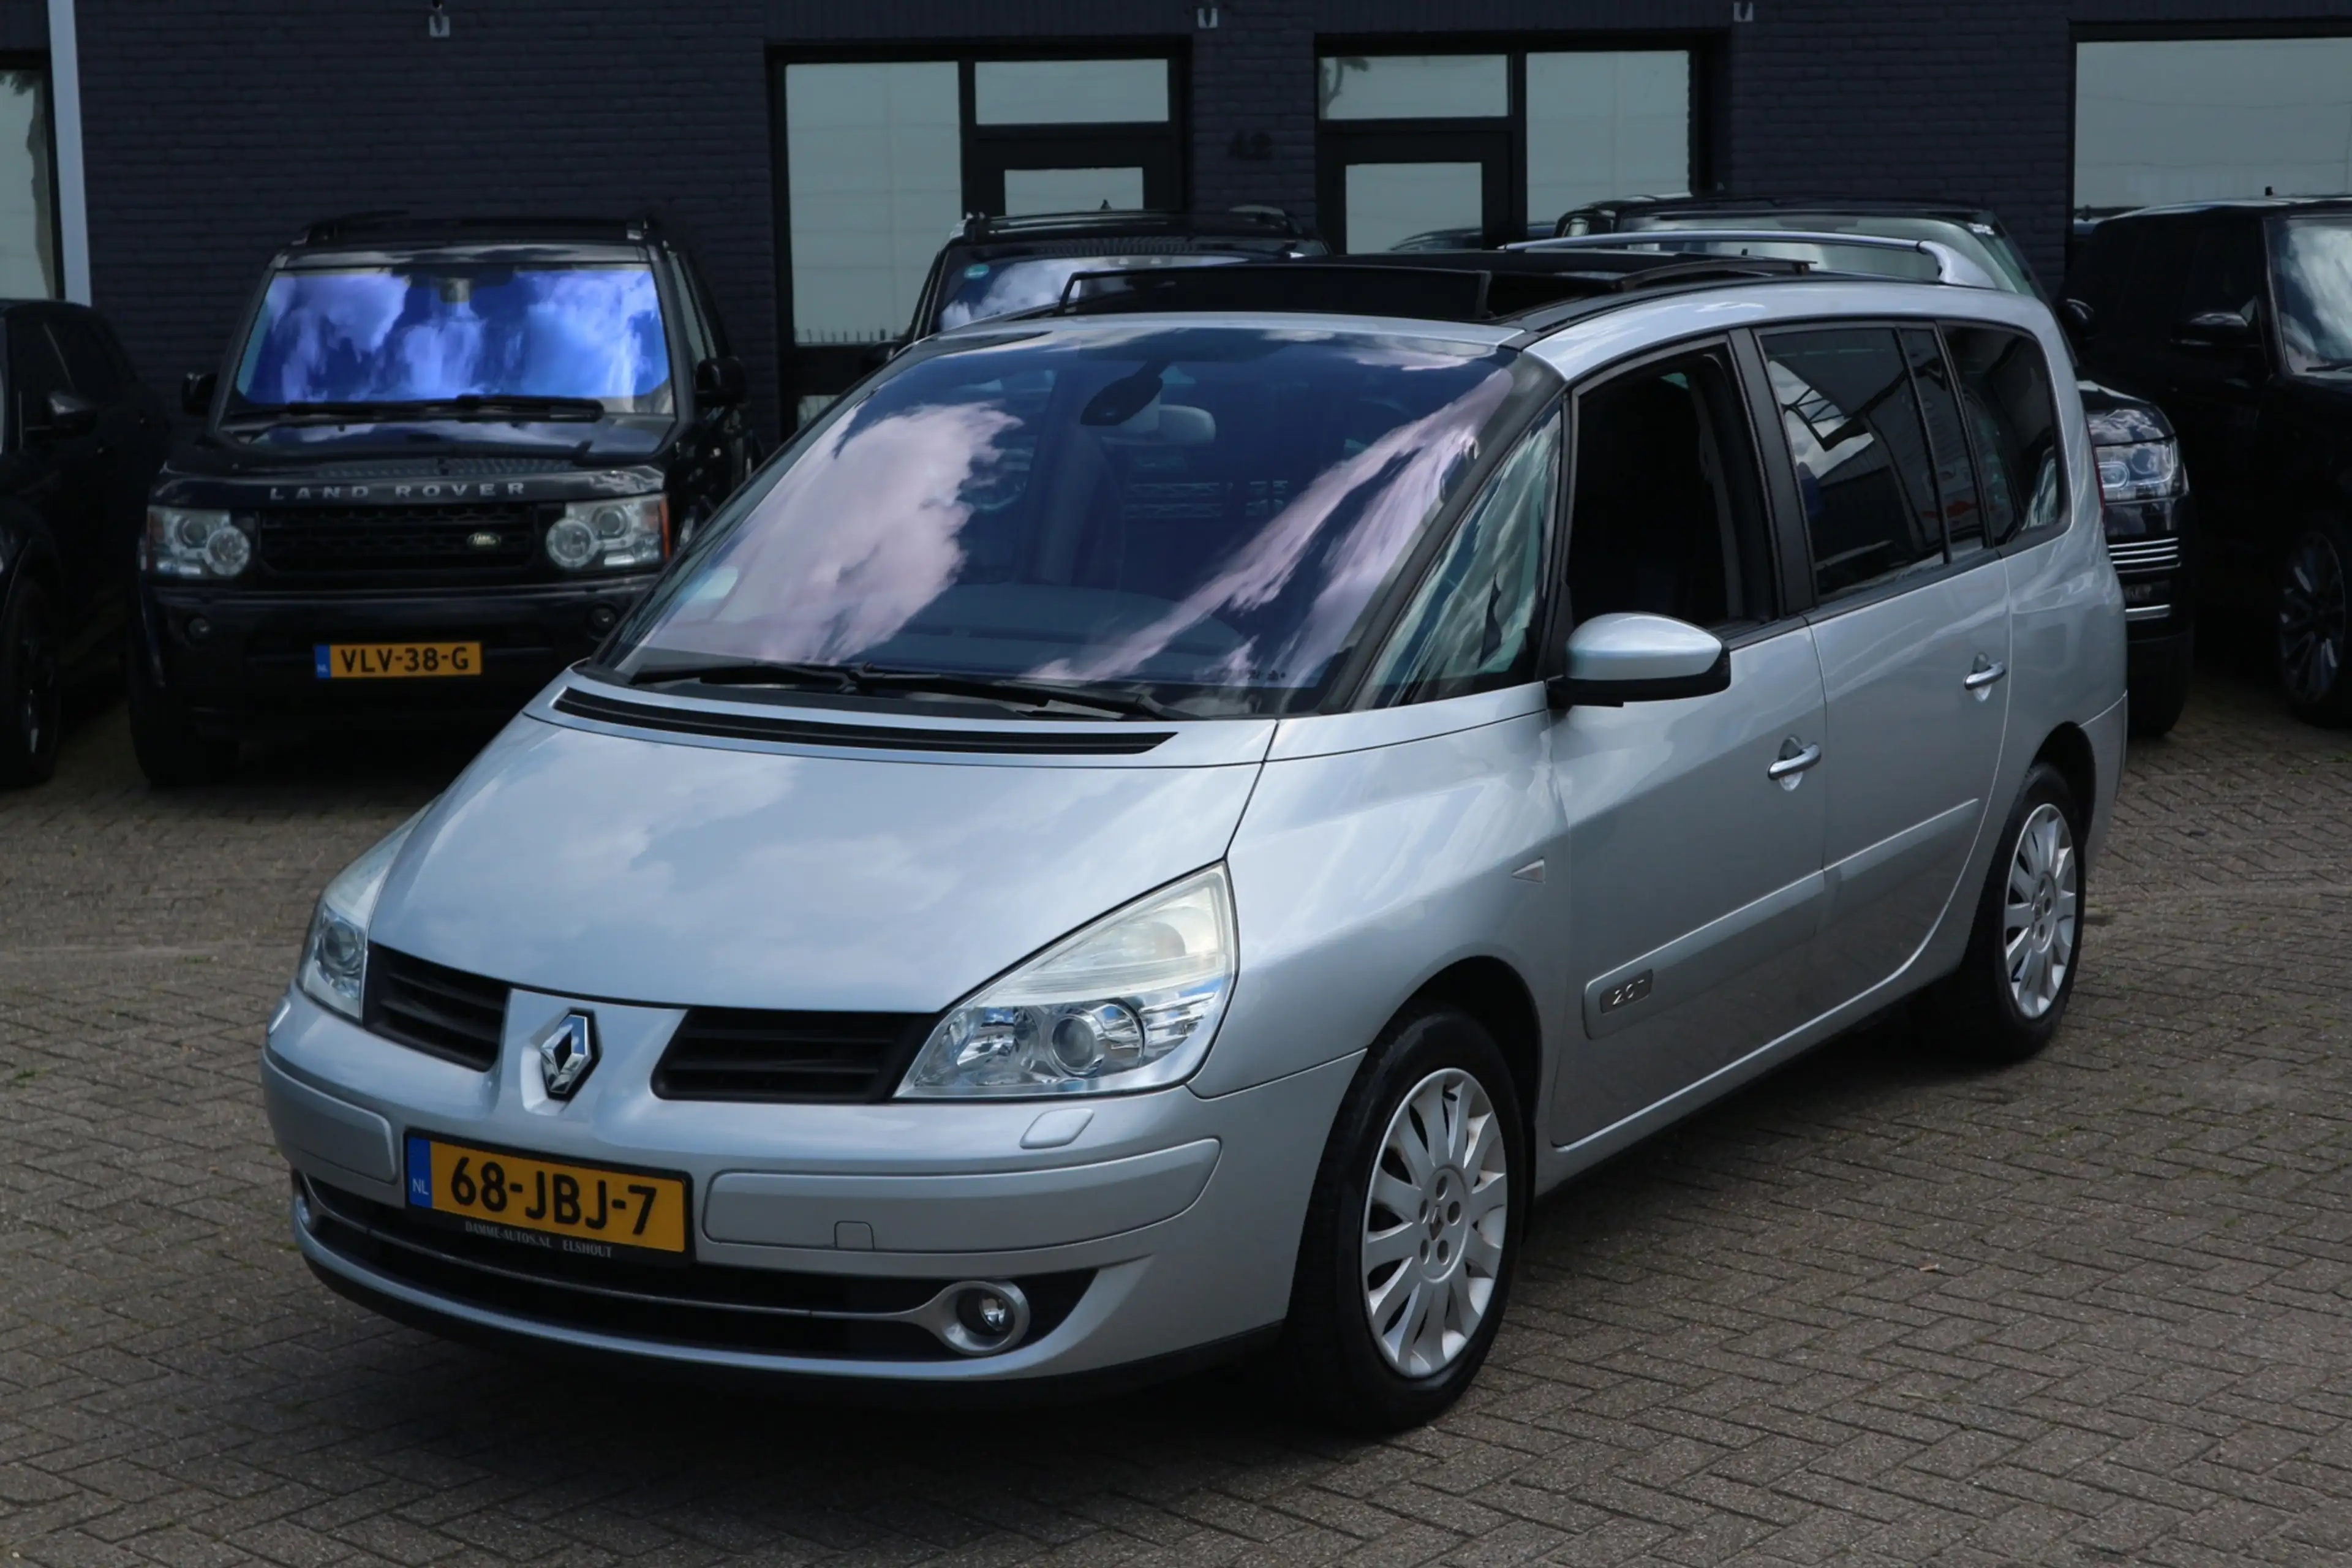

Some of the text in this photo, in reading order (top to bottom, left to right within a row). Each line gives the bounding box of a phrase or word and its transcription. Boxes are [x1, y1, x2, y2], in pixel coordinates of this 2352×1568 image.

[270, 483, 525, 500] LAND ROVER
[341, 646, 469, 673] VLV-38-G
[412, 1178, 429, 1196] NL
[450, 1156, 657, 1235] 68-JBJ-7
[562, 1239, 613, 1258] ELSHOUT
